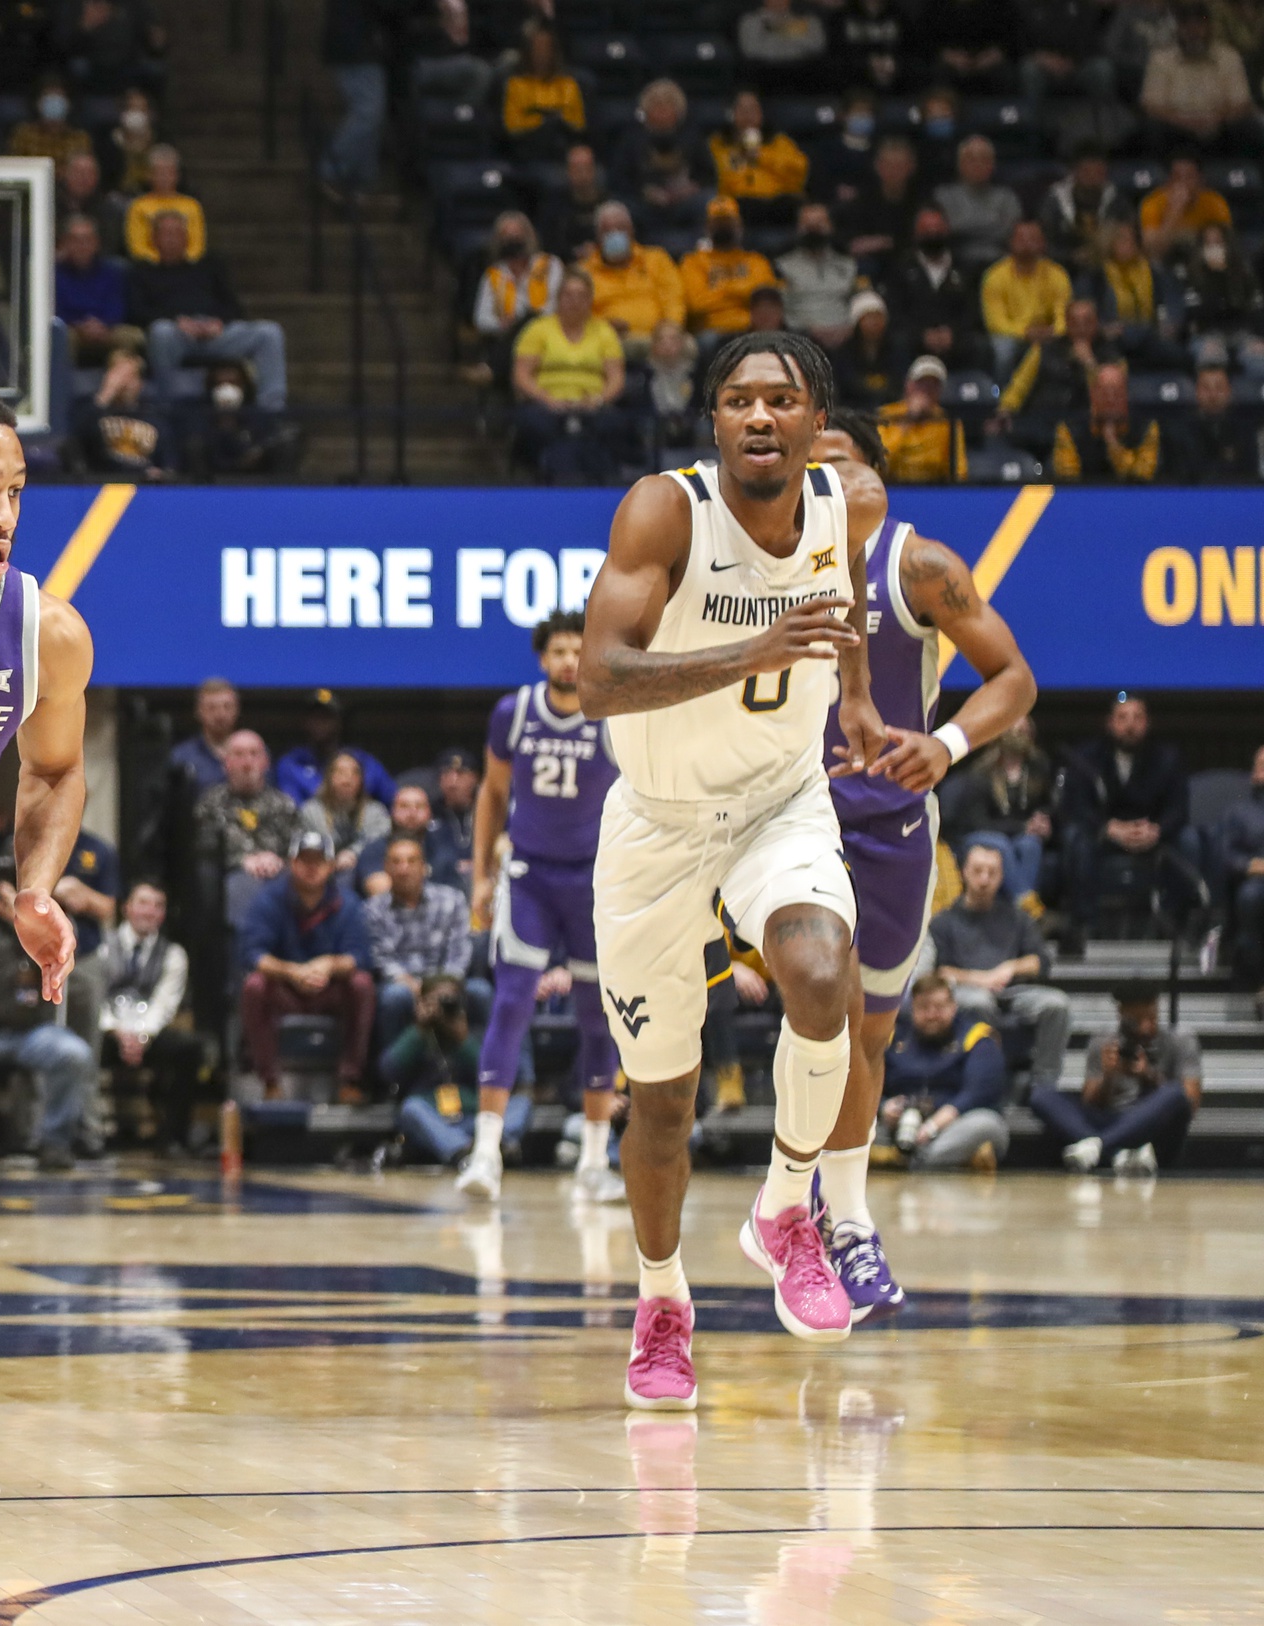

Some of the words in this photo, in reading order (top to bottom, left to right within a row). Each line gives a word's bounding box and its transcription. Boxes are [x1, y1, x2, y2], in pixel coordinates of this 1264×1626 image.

[221, 547, 433, 628] HERE
[1141, 546, 1264, 626] ON
[532, 755, 578, 798] 21
